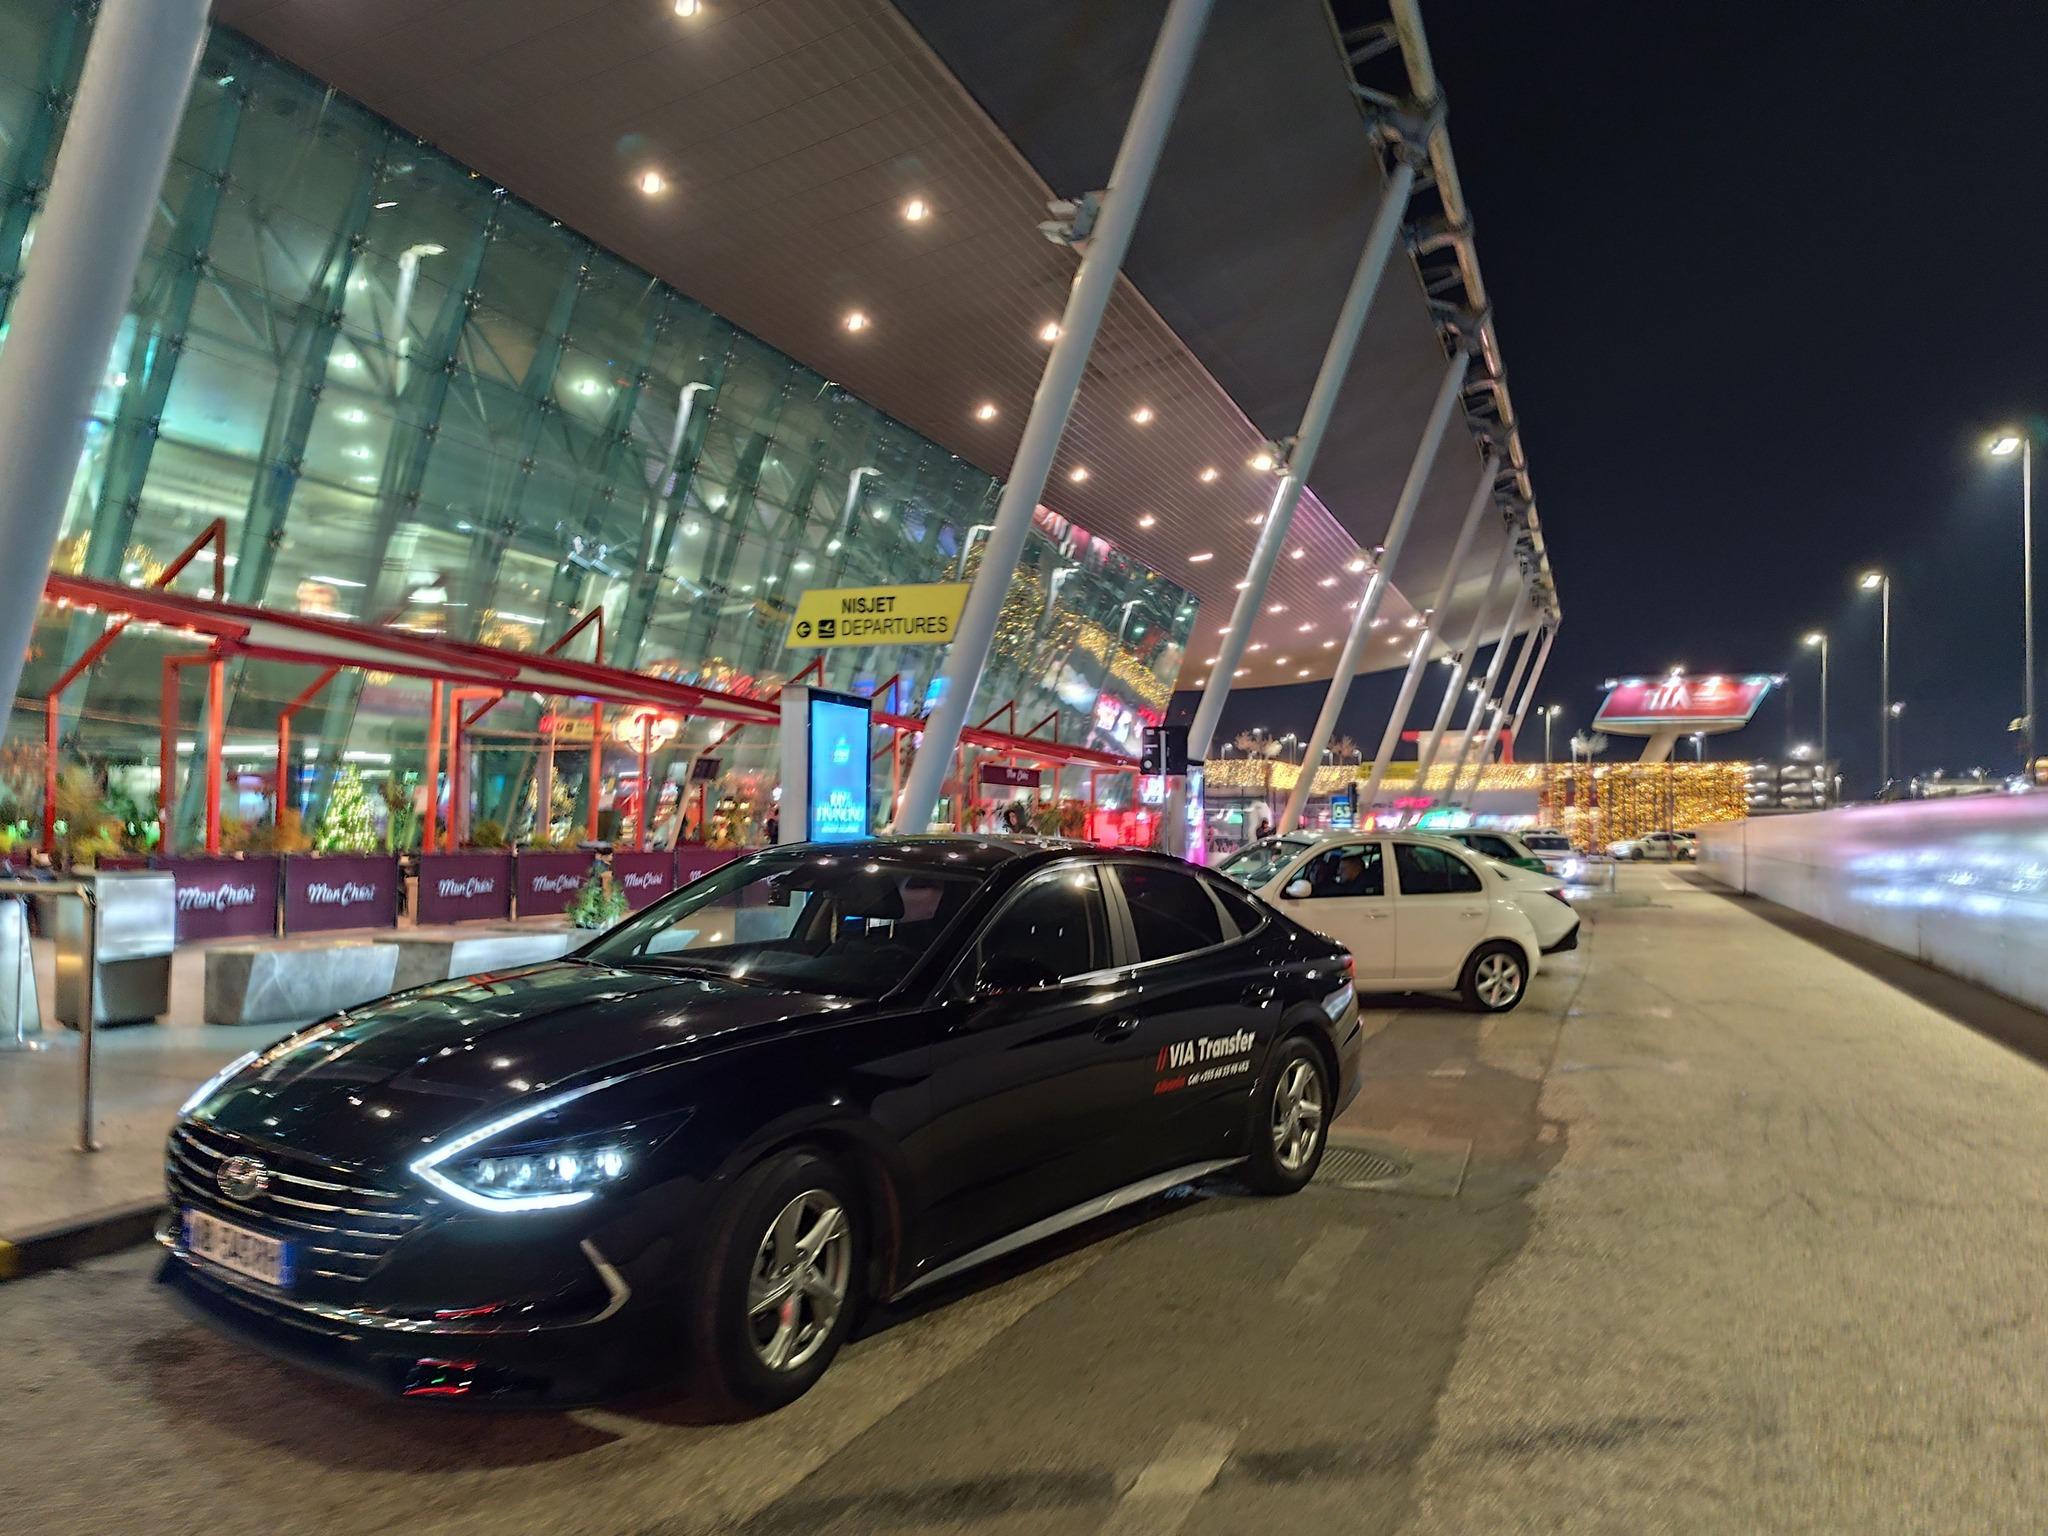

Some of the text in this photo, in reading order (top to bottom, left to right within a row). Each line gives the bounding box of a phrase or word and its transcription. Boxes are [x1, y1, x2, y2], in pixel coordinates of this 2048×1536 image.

[841, 596, 896, 614] NISJET
[841, 616, 948, 636] DEPARTURES
[1170, 1027, 1256, 1069] VIA Transfer
